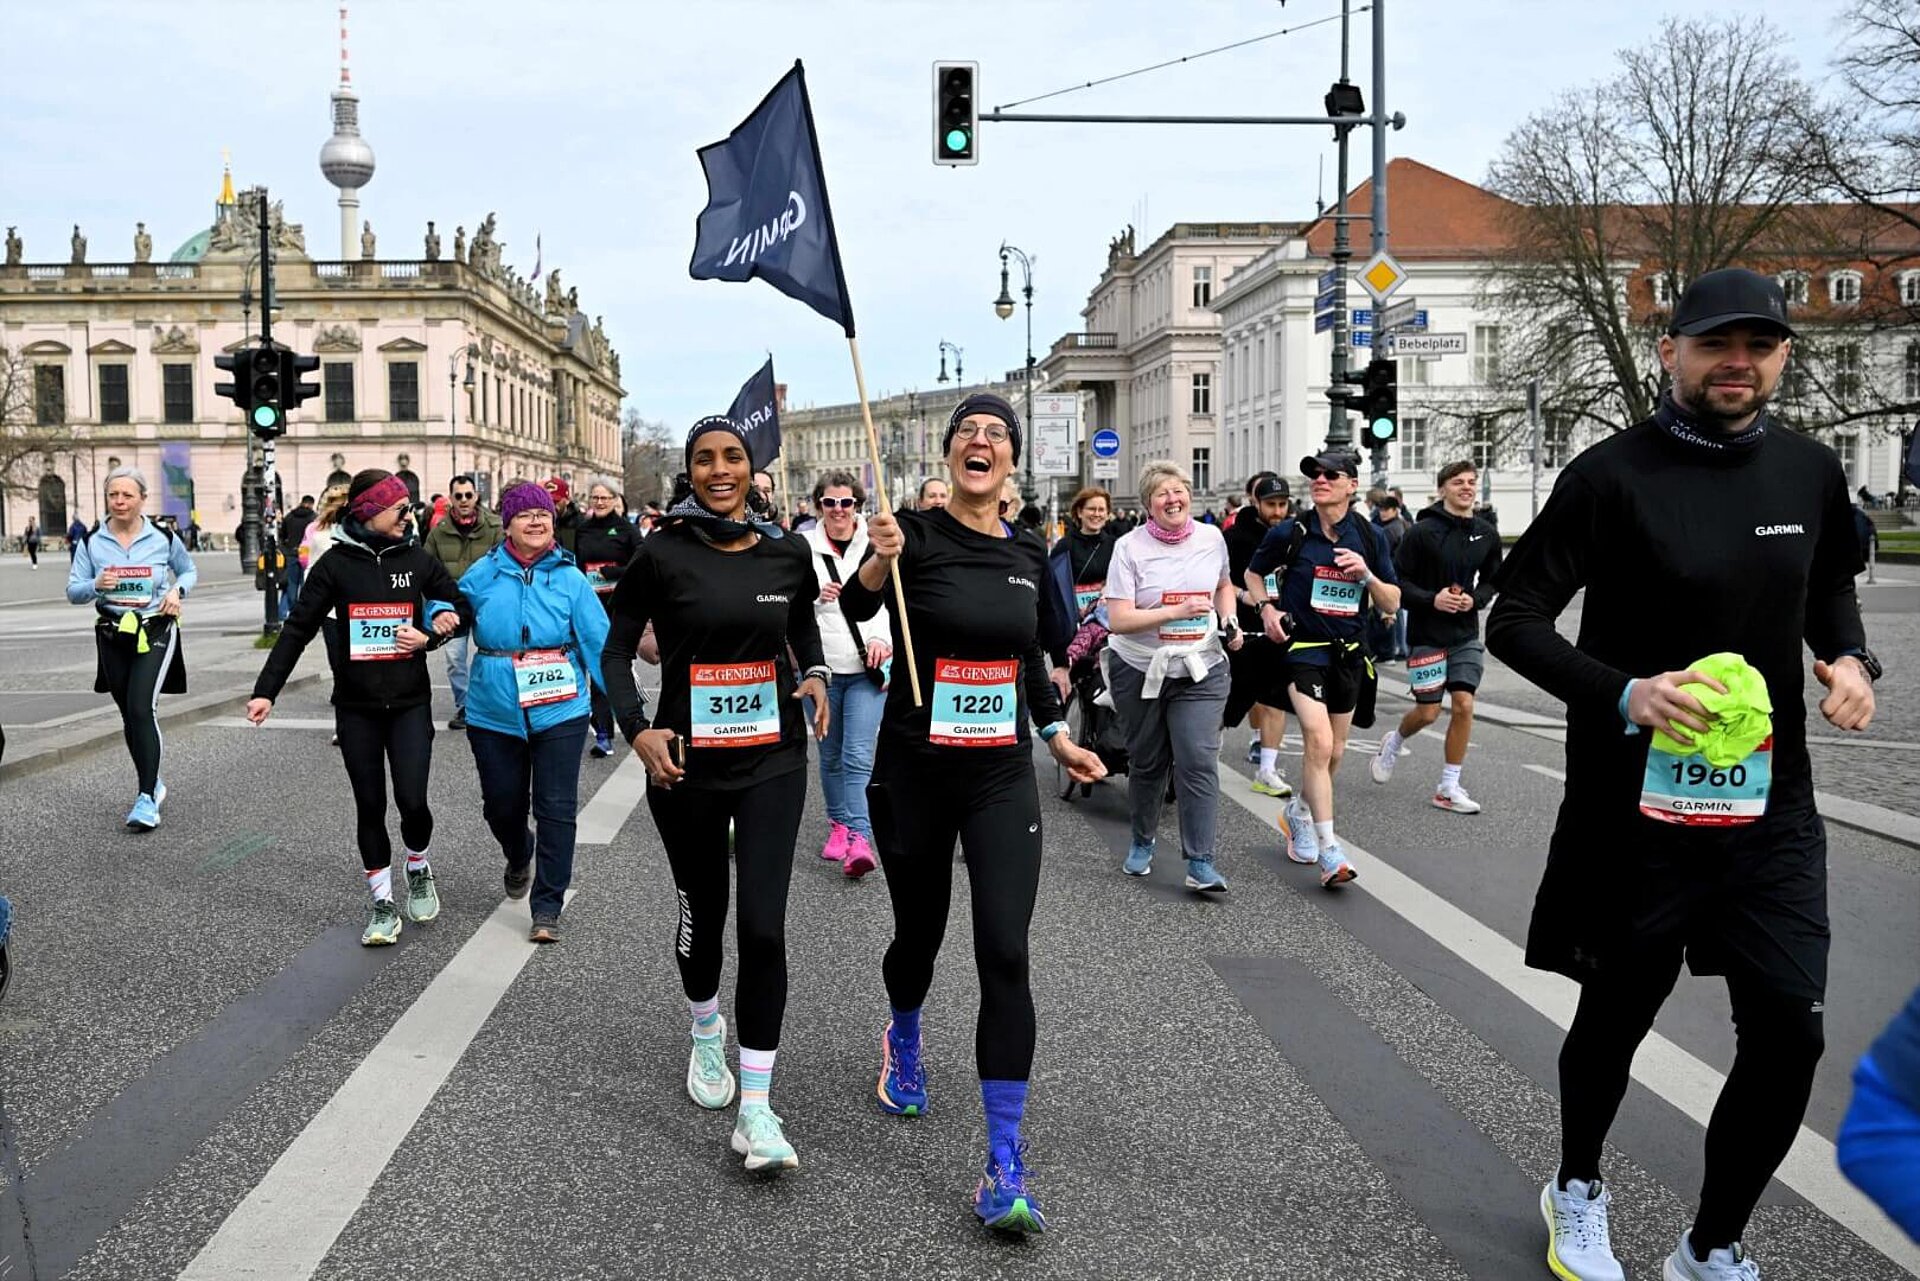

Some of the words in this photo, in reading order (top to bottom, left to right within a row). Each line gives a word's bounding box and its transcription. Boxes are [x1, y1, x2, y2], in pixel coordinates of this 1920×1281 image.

[1399, 337, 1460, 350] Bebelplatz
[1321, 584, 1355, 599] 2560
[366, 606, 409, 615] GENERALI
[528, 668, 565, 685] 2782
[715, 664, 771, 681] GENERALI
[961, 664, 1013, 680] GENERALI
[1415, 666, 1442, 680] 2904
[709, 694, 762, 714] 3124
[952, 694, 1003, 713] 1220
[714, 725, 757, 735] GARMIN
[953, 726, 997, 734] GARMIN
[1671, 760, 1747, 787] 1960
[1672, 800, 1733, 811] GARMIN
